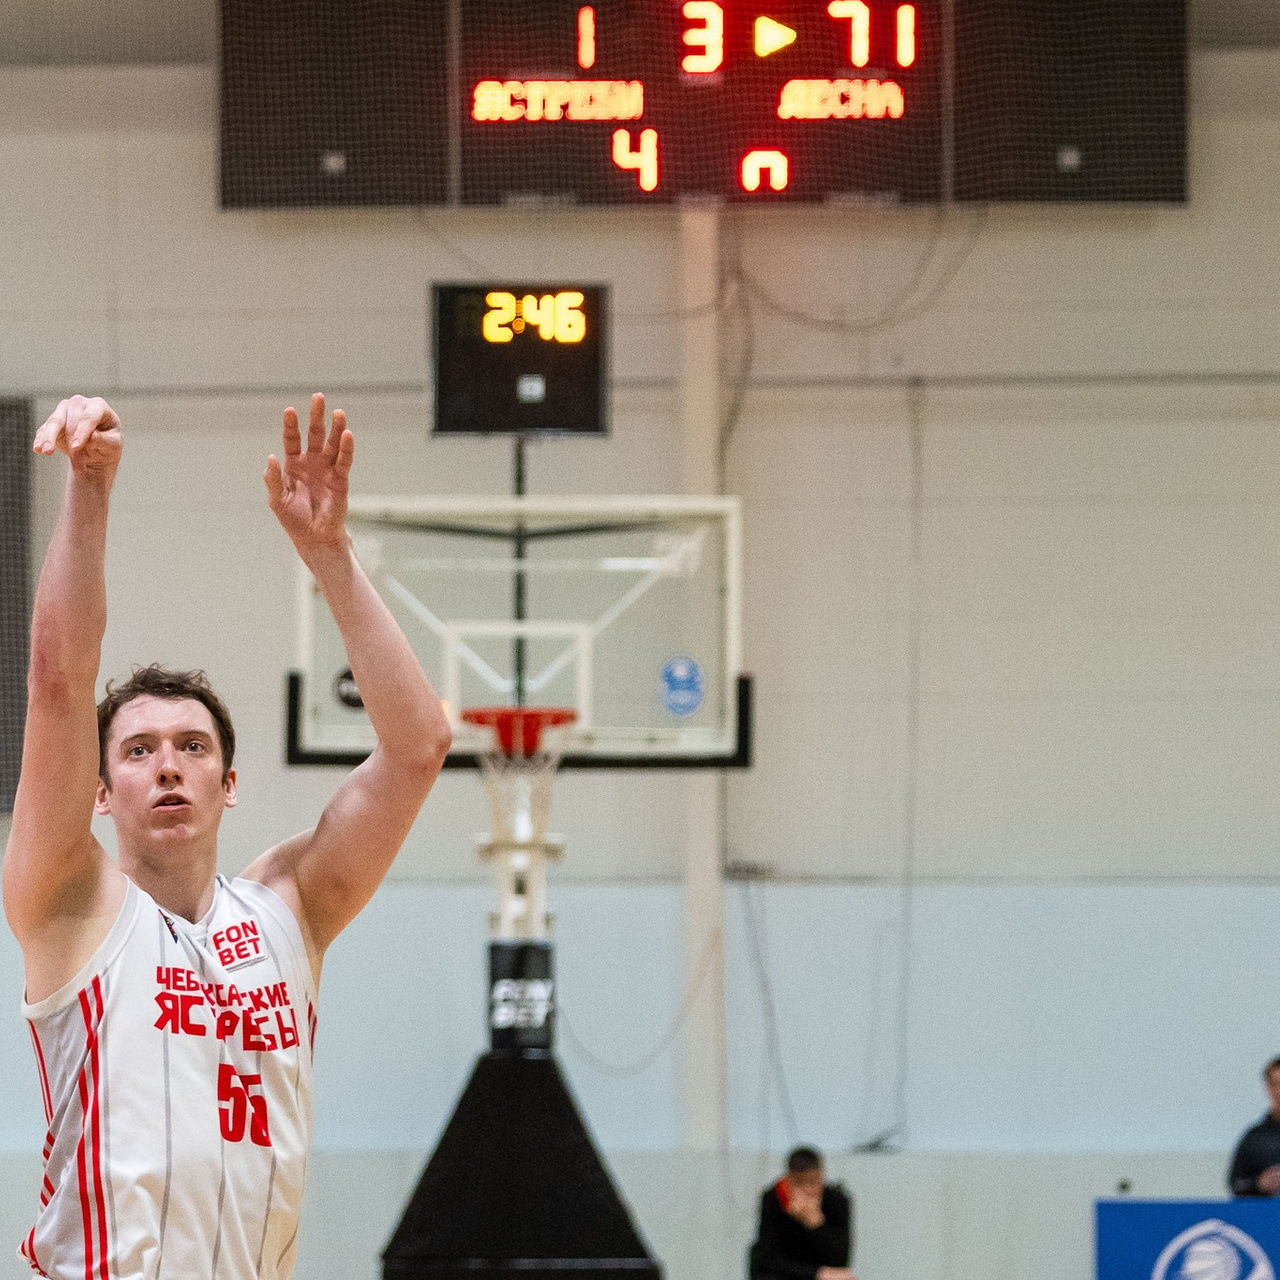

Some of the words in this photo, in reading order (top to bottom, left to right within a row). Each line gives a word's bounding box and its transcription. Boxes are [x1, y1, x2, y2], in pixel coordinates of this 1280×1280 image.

[682, 1, 724, 73] 3
[612, 128, 658, 192] 4
[483, 292, 586, 343] 2:46
[212, 920, 258, 950] FON
[218, 938, 260, 966] BET
[154, 992, 300, 1051] ЯСРЕБЫ
